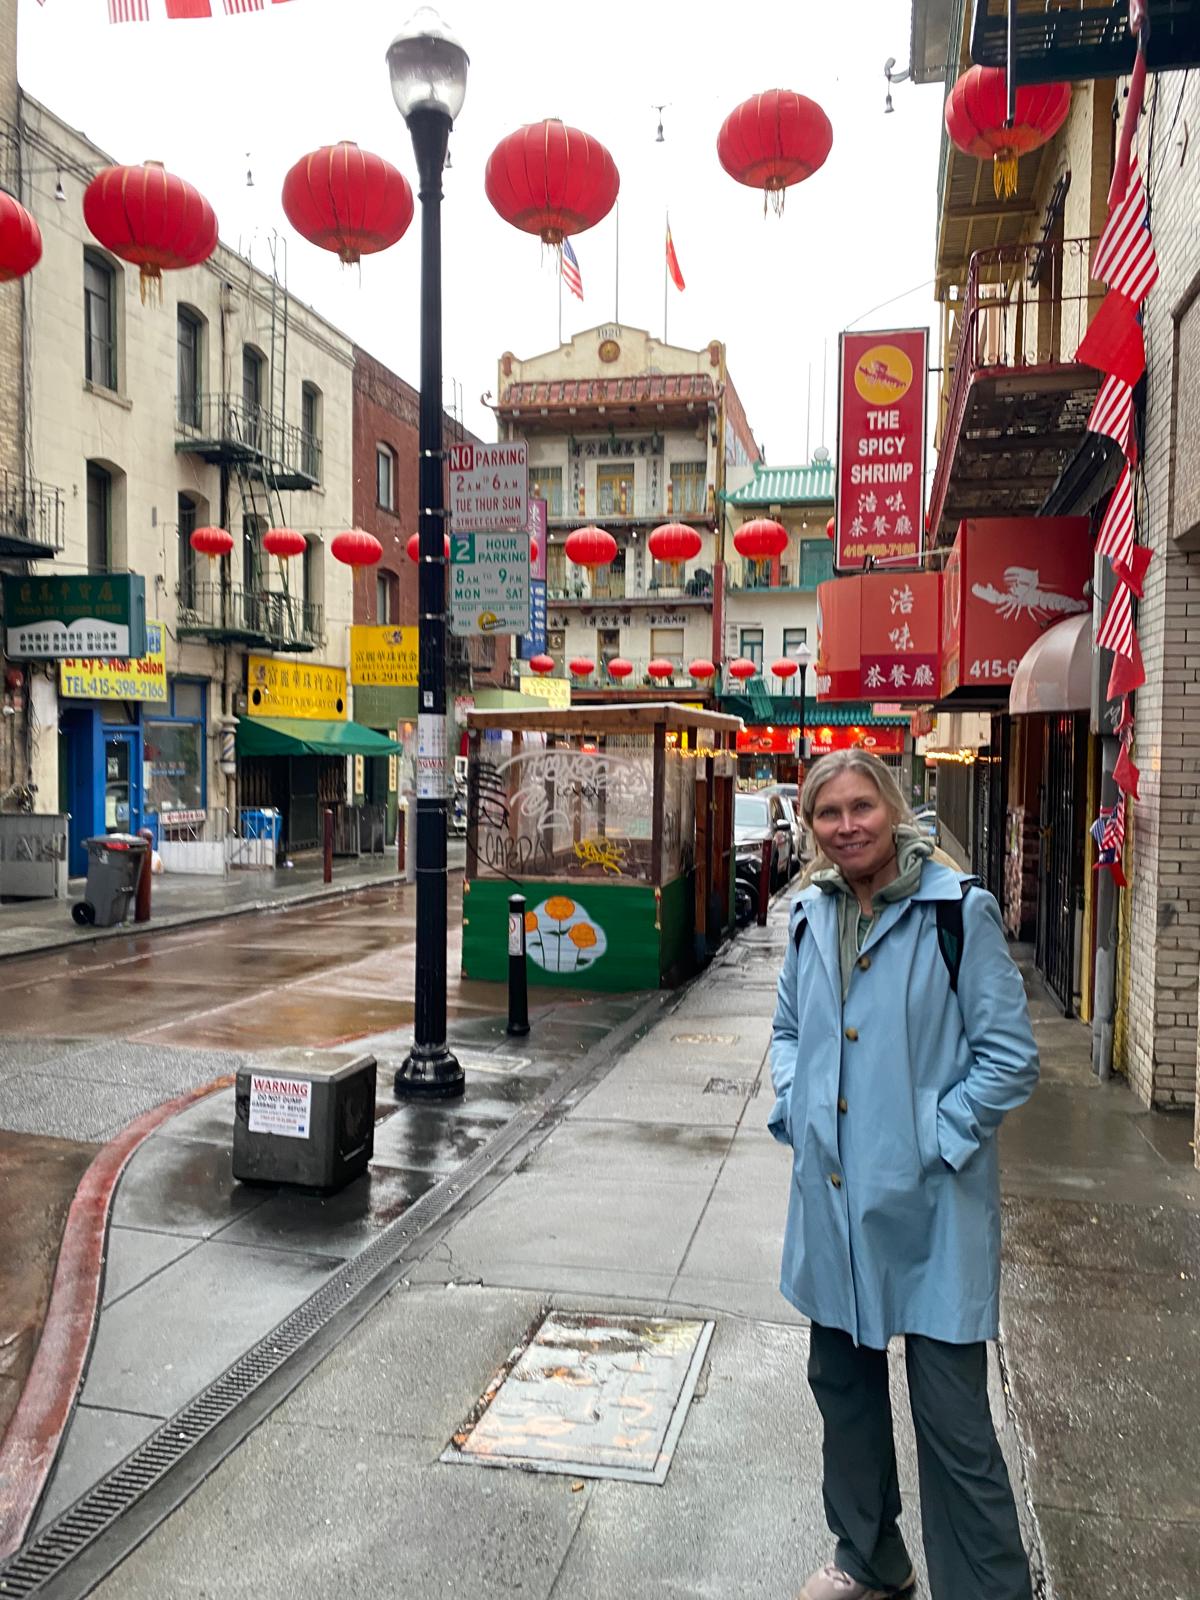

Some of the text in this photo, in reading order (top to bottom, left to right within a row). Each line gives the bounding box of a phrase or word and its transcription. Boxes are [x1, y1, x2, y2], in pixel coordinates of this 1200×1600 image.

[866, 410, 900, 430] THE
[858, 436, 906, 456] SPICY
[450, 446, 525, 470] NO PARKING
[456, 475, 464, 492] 2
[492, 474, 500, 490] 6
[851, 462, 913, 485] SHRIMP
[456, 496, 521, 512] TUE THUR SUN
[858, 490, 906, 514] 浩味
[456, 515, 521, 528] STREET CLEANING
[849, 515, 912, 538] 茶餐廳
[456, 538, 517, 560] 2 HOUR
[478, 551, 527, 563] PARKING
[456, 569, 464, 584] 8
[498, 568, 507, 584] 9
[455, 588, 480, 599] MON
[506, 588, 523, 599] SAT
[889, 584, 914, 650] 浩味
[136, 656, 164, 675] Salon
[970, 660, 1019, 678] 415-6
[864, 664, 934, 688] 茶餐廳
[254, 1078, 308, 1096] WARNING
[282, 1096, 302, 1104] DUMP
